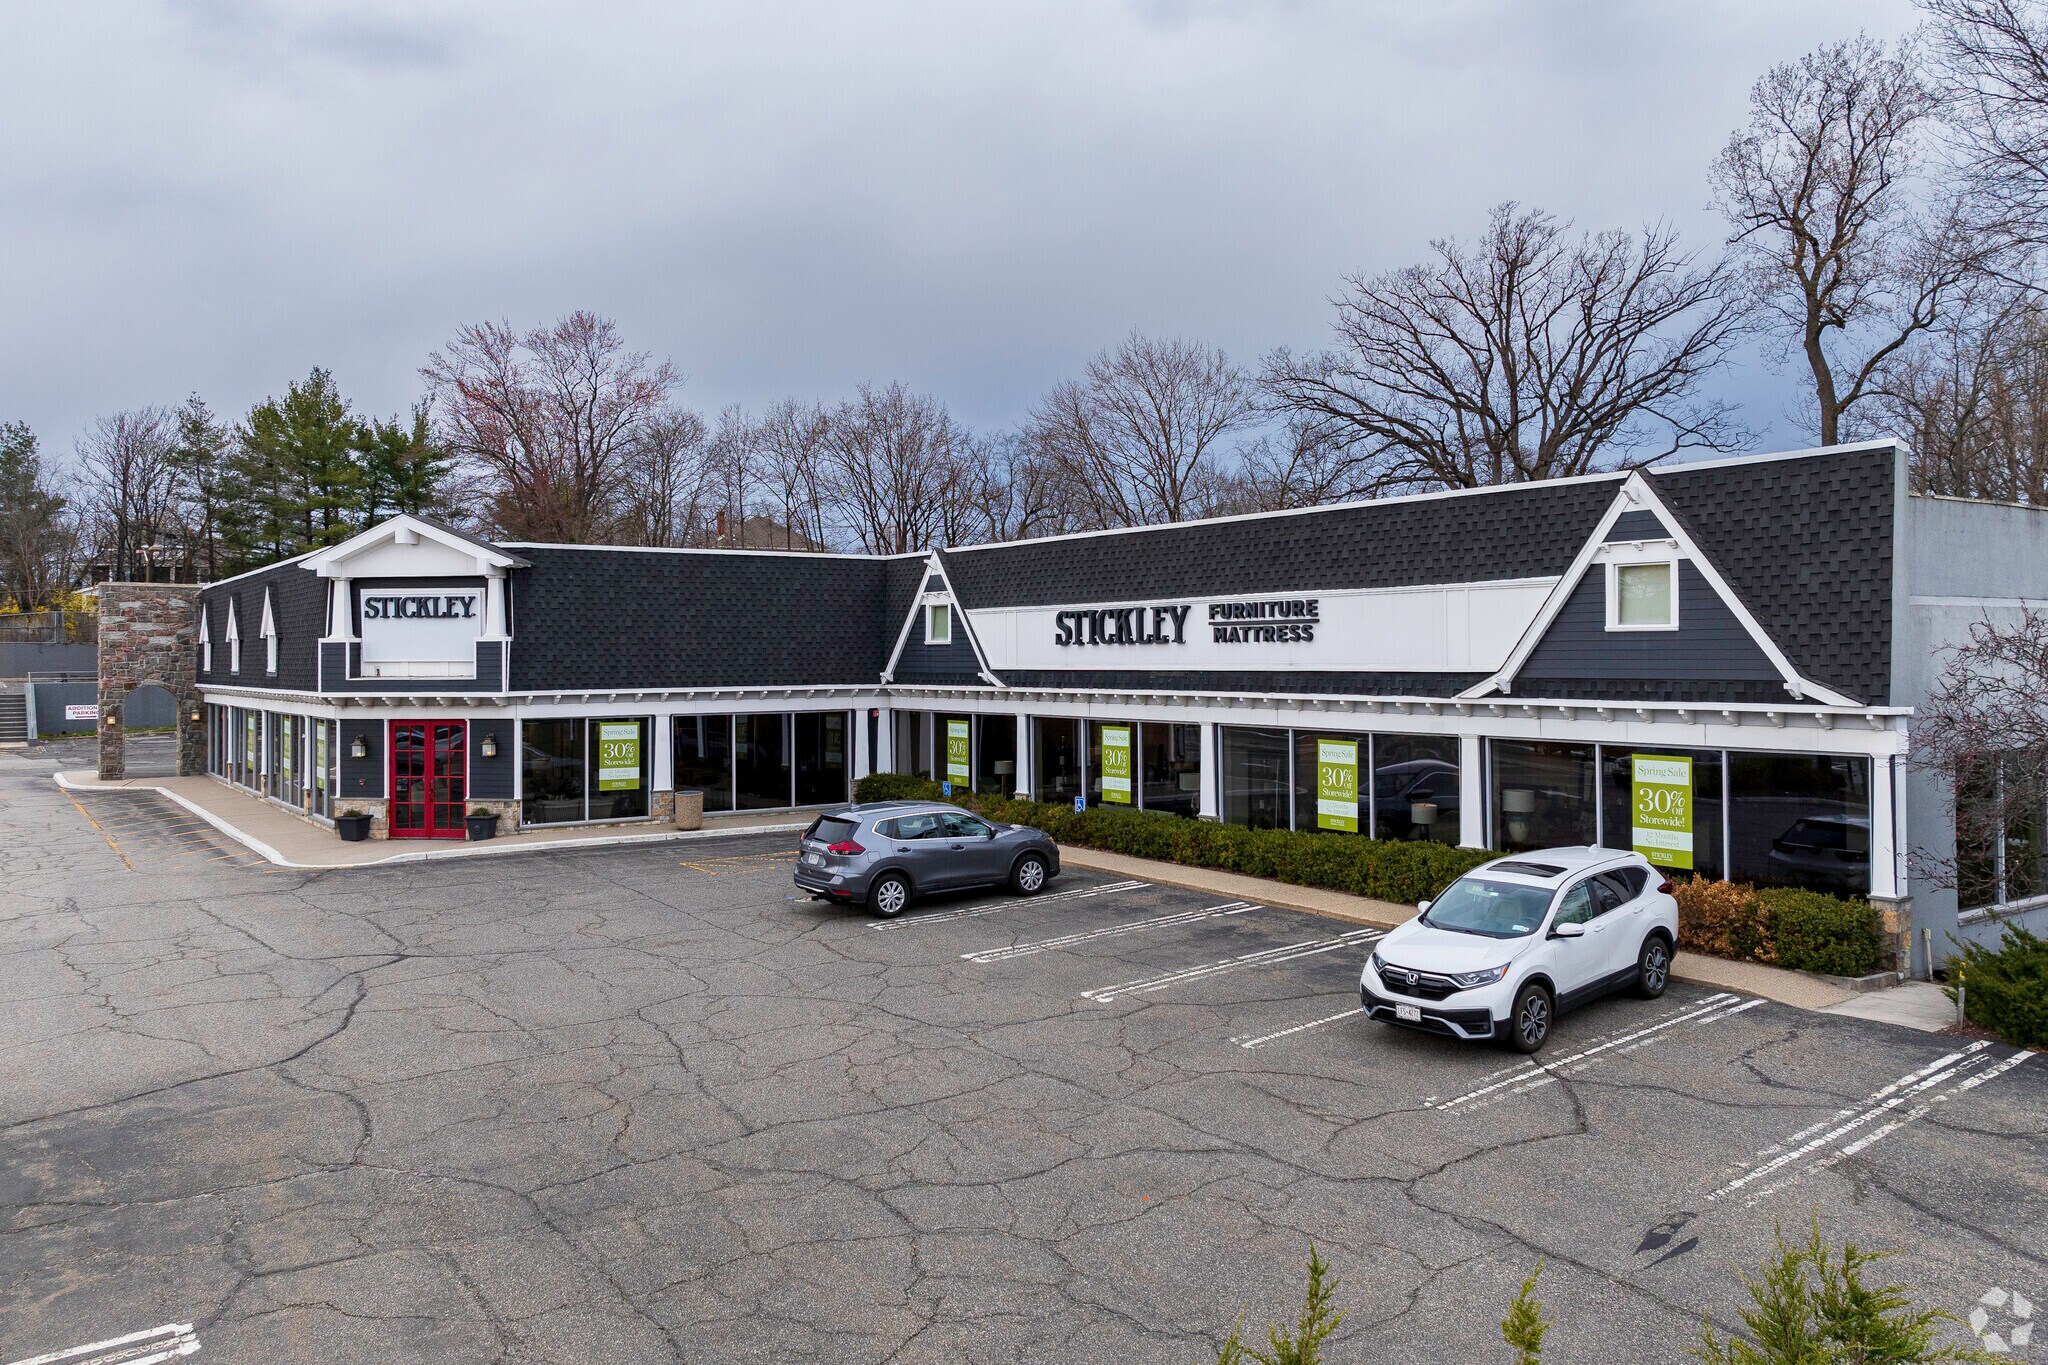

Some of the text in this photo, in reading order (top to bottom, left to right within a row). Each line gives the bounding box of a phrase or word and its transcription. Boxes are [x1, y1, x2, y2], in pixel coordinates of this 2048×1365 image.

[364, 596, 476, 618] STICKLEY
[1208, 599, 1319, 620] FURNITURE
[1055, 605, 1191, 646] STICKLEY
[1213, 624, 1314, 644] MATTRESS
[1104, 734, 1118, 742] Spring
[604, 742, 636, 758] 30%
[950, 740, 966, 754] 30%
[1322, 748, 1354, 759] Spring Sale
[1105, 748, 1128, 766] 30%
[1322, 766, 1354, 788] 30%
[1638, 766, 1686, 778] Spring Sale
[1322, 788, 1353, 798] Storewide!
[1639, 788, 1686, 814] 30%
[1672, 808, 1684, 816] Off
[1640, 813, 1685, 828] Storewide!
[1653, 832, 1679, 840] Months
[1656, 838, 1680, 848] Interest
